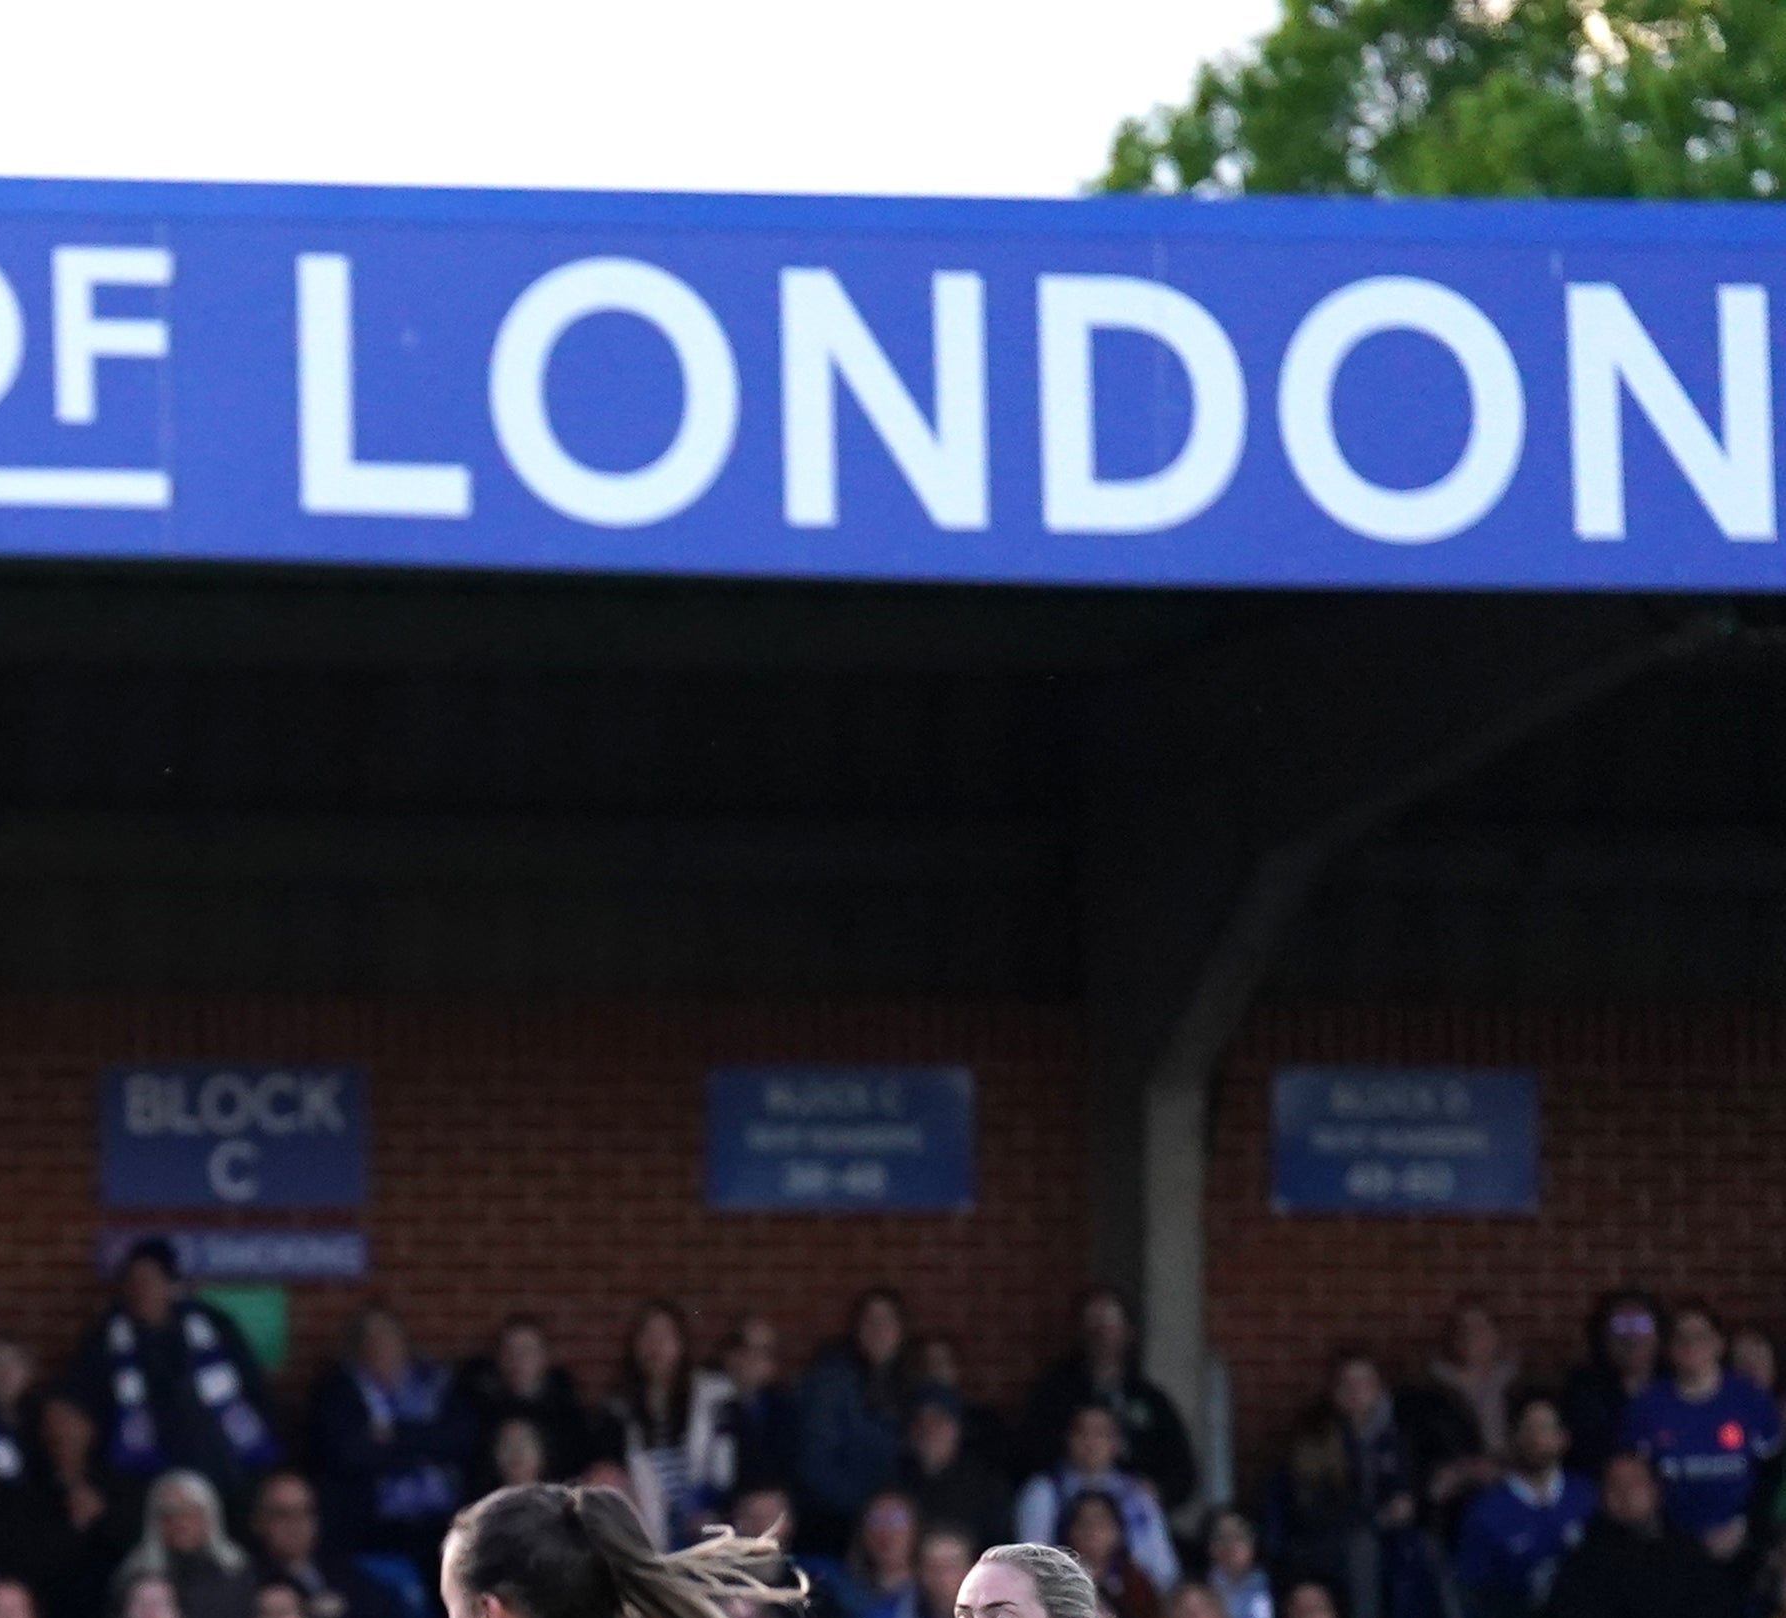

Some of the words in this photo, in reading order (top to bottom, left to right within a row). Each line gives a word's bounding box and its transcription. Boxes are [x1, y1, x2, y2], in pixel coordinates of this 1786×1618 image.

[298, 254, 1779, 545] LONDON
[124, 1072, 346, 1136] BLOCK
[207, 1139, 261, 1203] C
